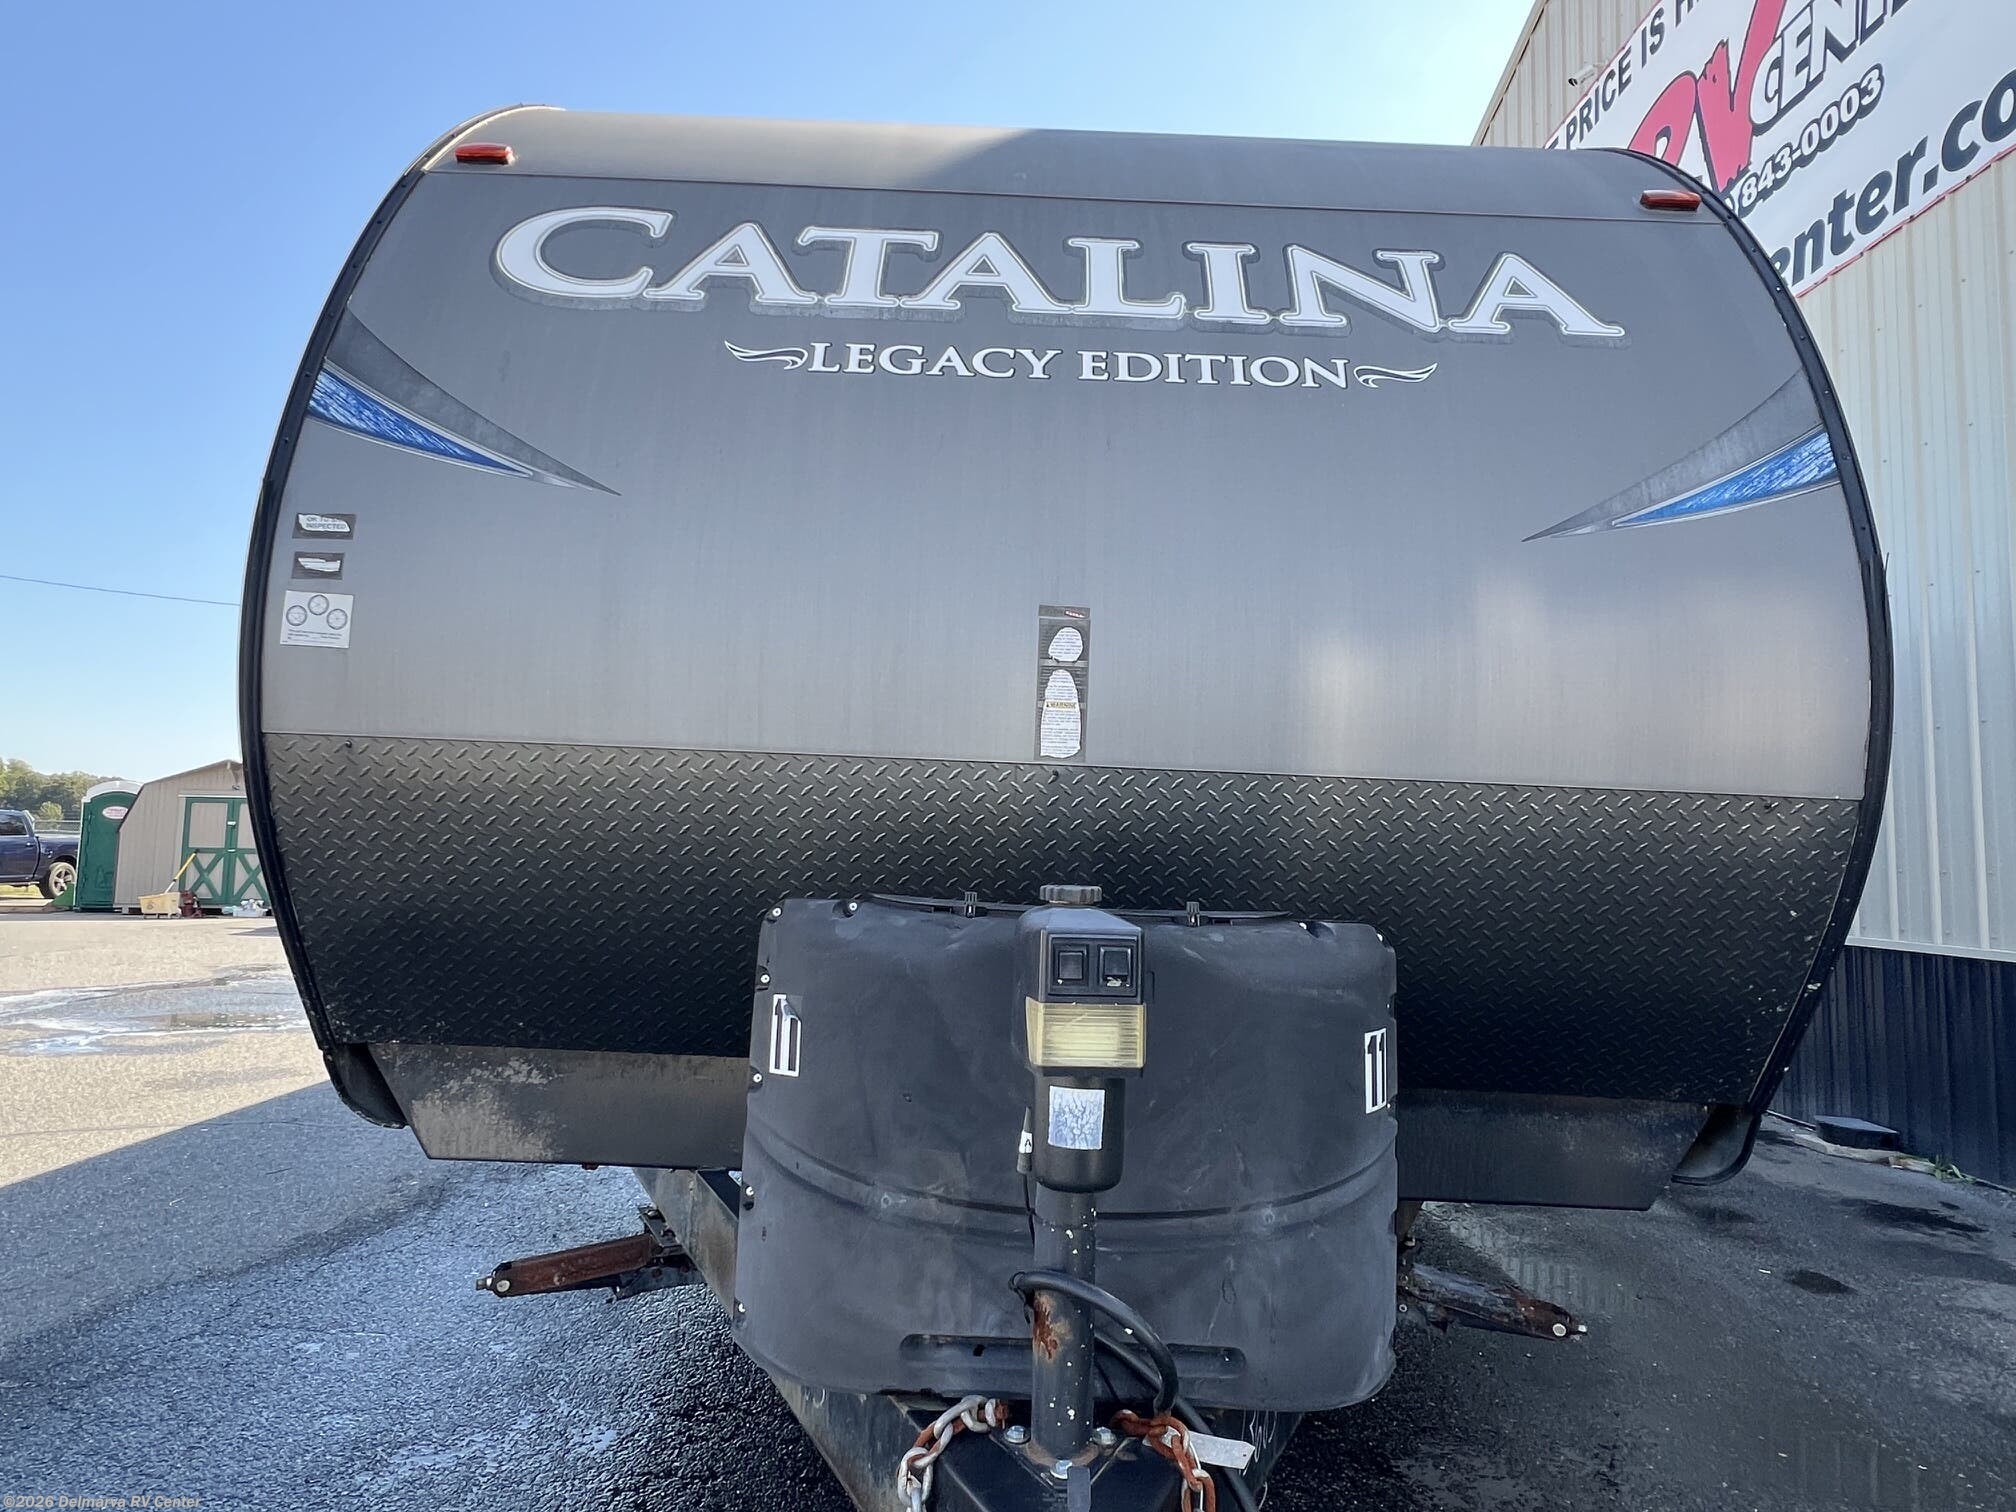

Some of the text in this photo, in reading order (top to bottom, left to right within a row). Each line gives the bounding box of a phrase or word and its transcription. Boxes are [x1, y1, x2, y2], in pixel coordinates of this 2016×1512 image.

[1565, 7, 1665, 150] PRICE IS
[494, 205, 1627, 339] CATALINA
[807, 341, 1349, 389] LEGACY EDITION
